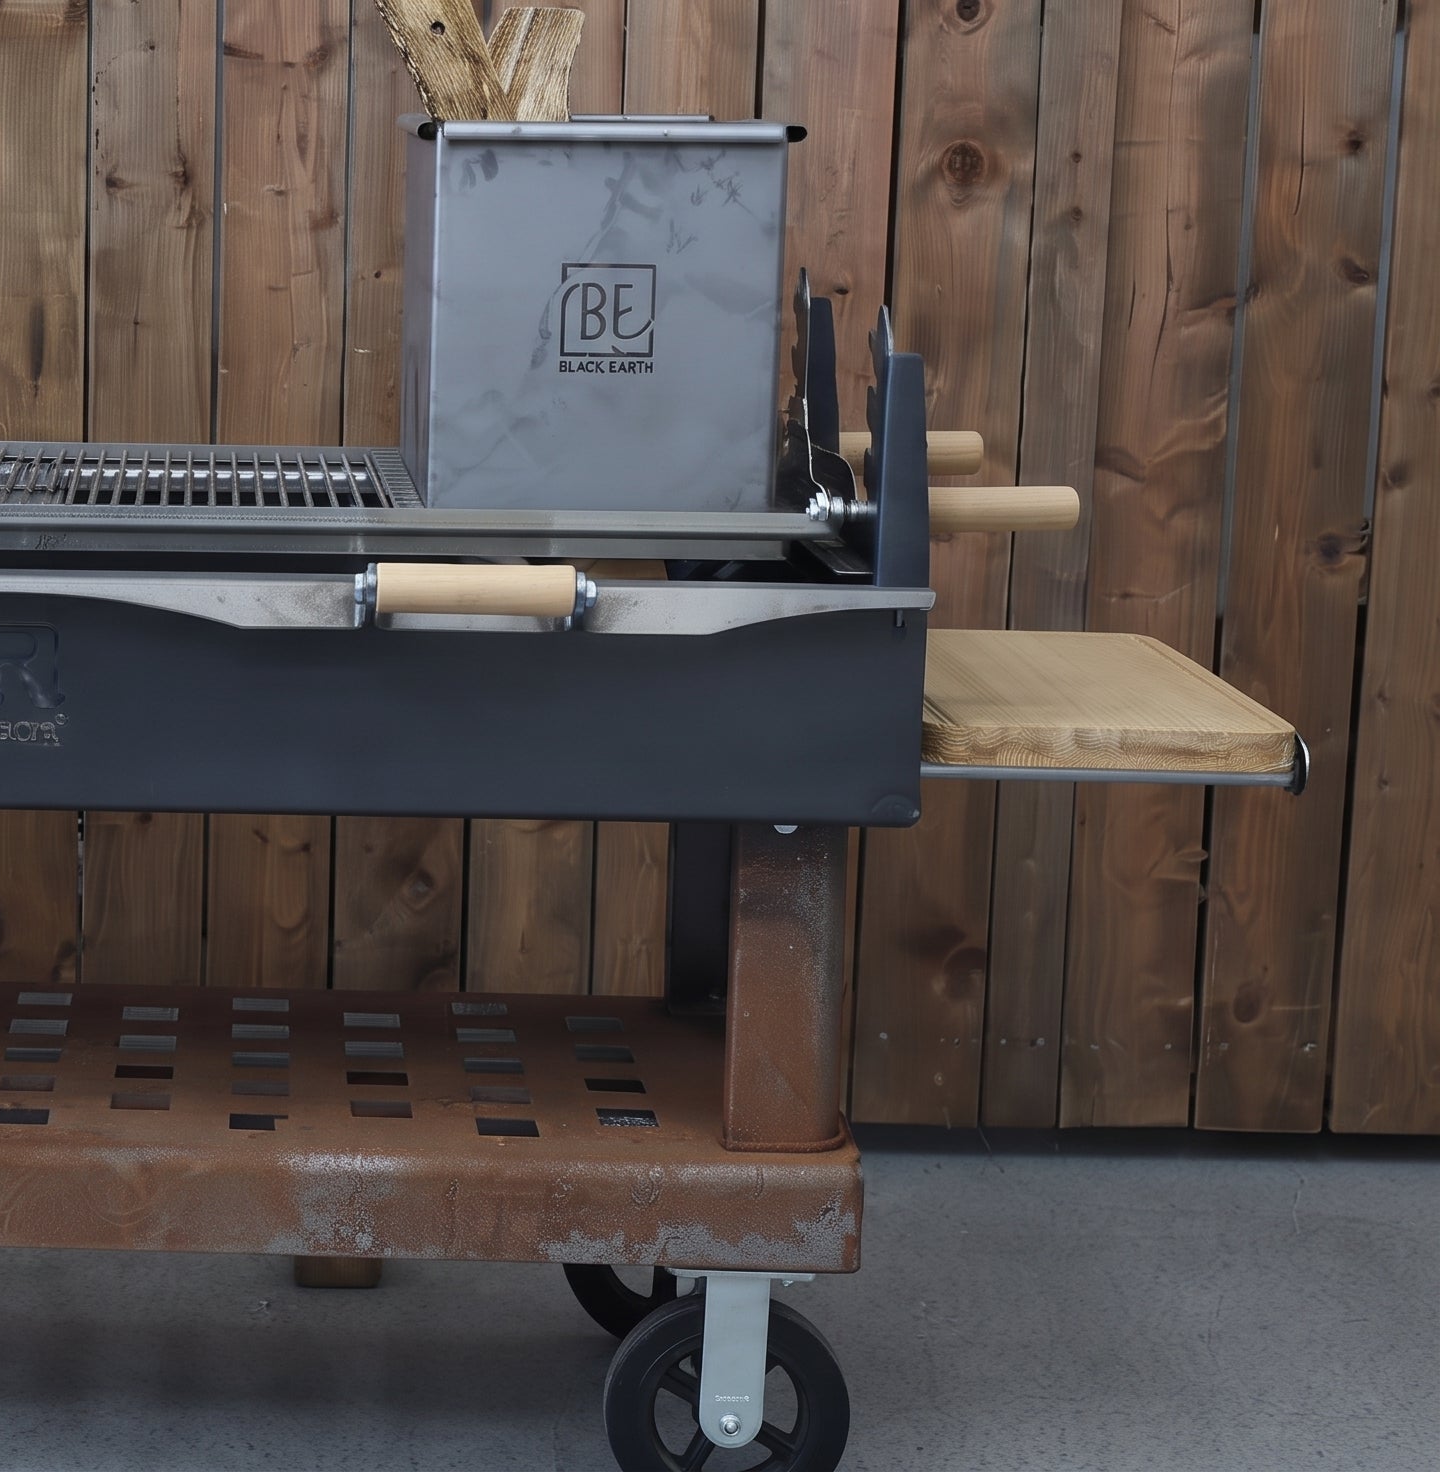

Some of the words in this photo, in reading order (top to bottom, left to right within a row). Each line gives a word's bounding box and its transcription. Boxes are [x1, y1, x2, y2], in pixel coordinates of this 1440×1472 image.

[580, 282, 652, 340] BE
[560, 360, 605, 374] BLACK
[609, 361, 653, 374] EARTH
